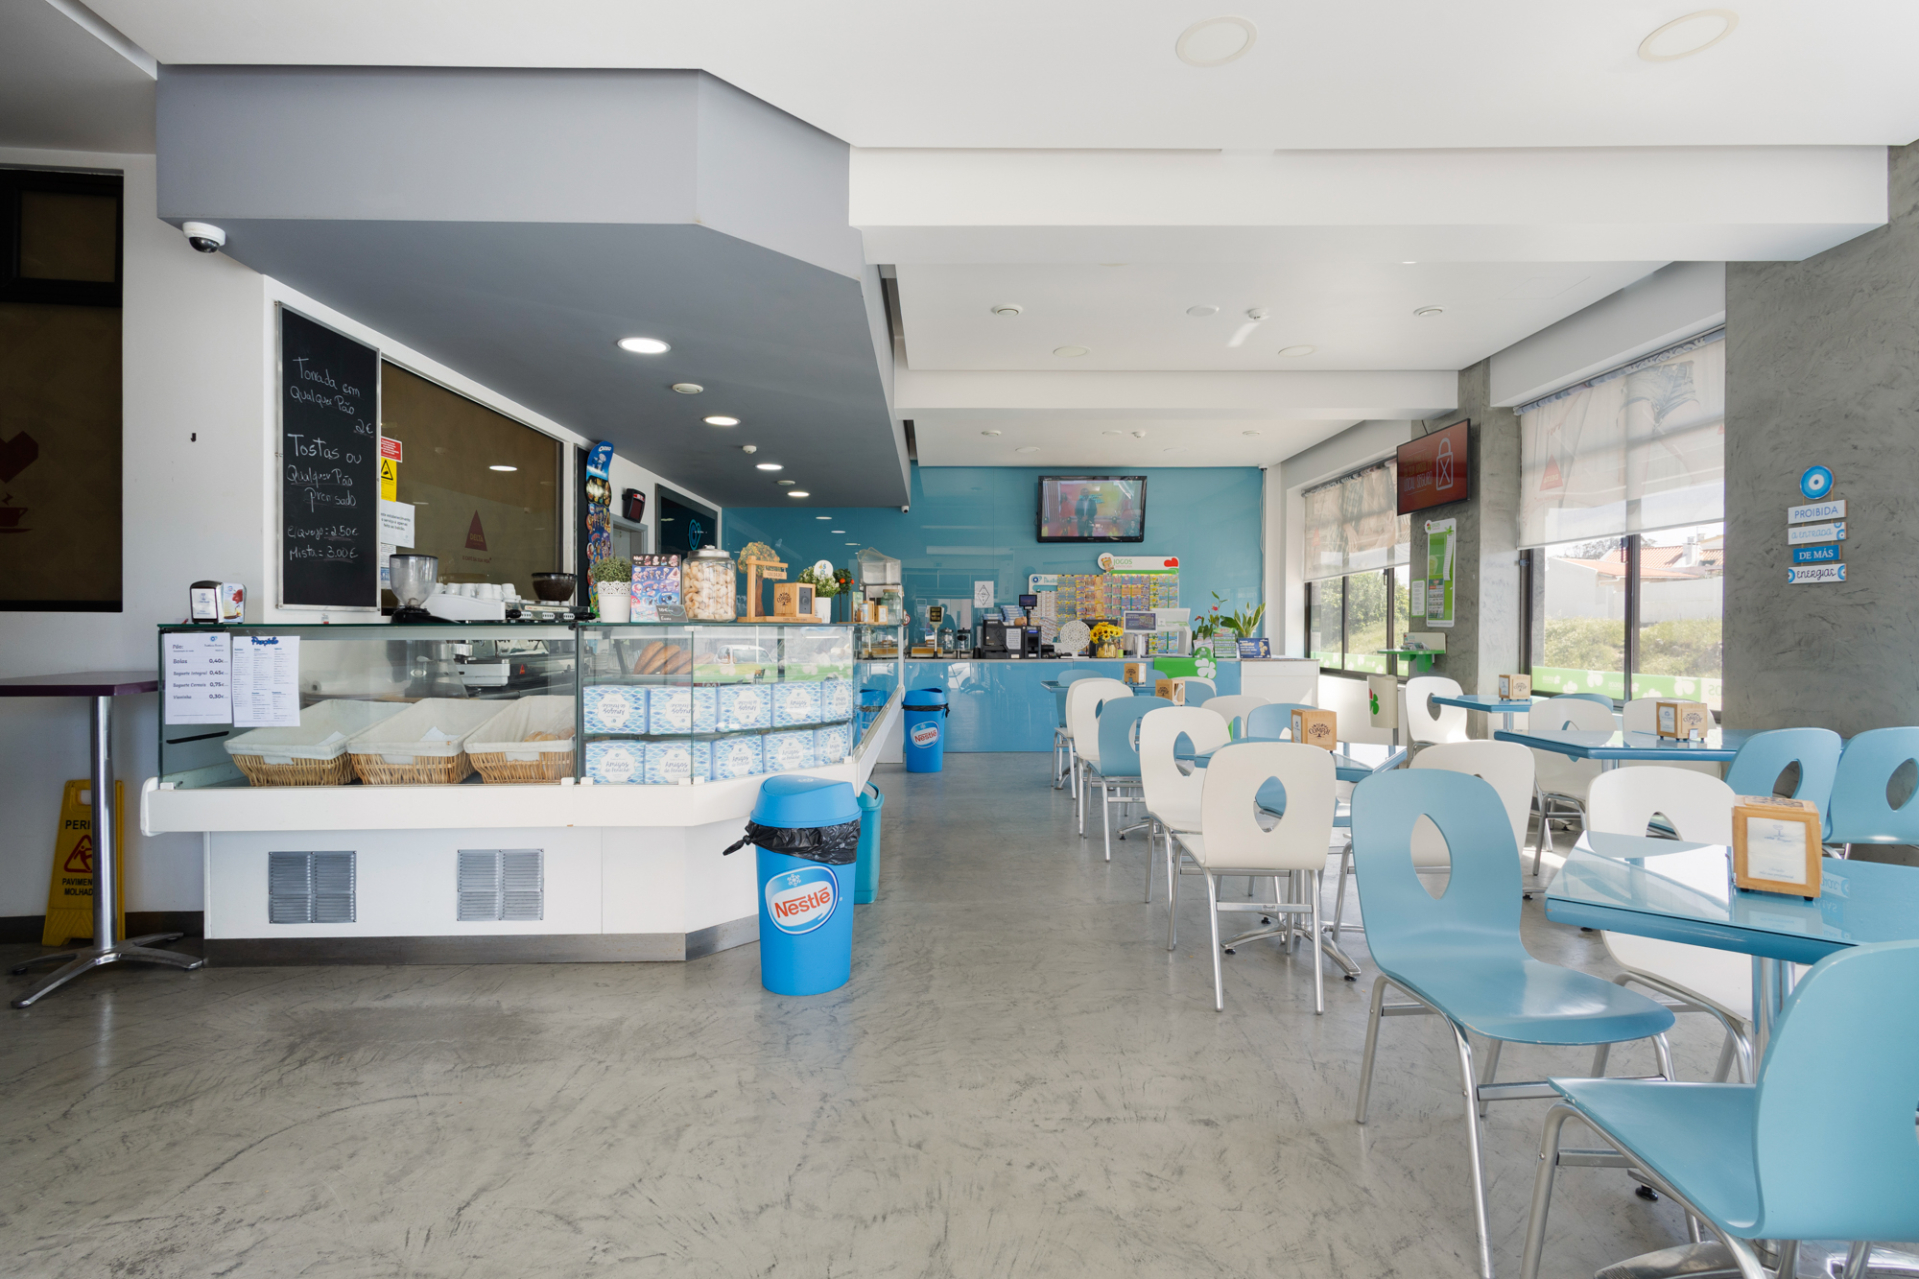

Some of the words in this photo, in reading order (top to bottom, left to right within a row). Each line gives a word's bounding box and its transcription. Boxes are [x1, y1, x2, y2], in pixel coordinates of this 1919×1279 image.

[287, 433, 340, 460] Tostas
[1794, 506, 1838, 518] PROIBIDA
[1799, 552, 1812, 560] DE
[1813, 548, 1834, 558] MÁS
[914, 729, 938, 742] Nestlé
[65, 819, 91, 830] PERI
[62, 878, 93, 886] PAVIMEN
[64, 888, 94, 896] MOLHAD
[774, 886, 831, 918] Nestlé
